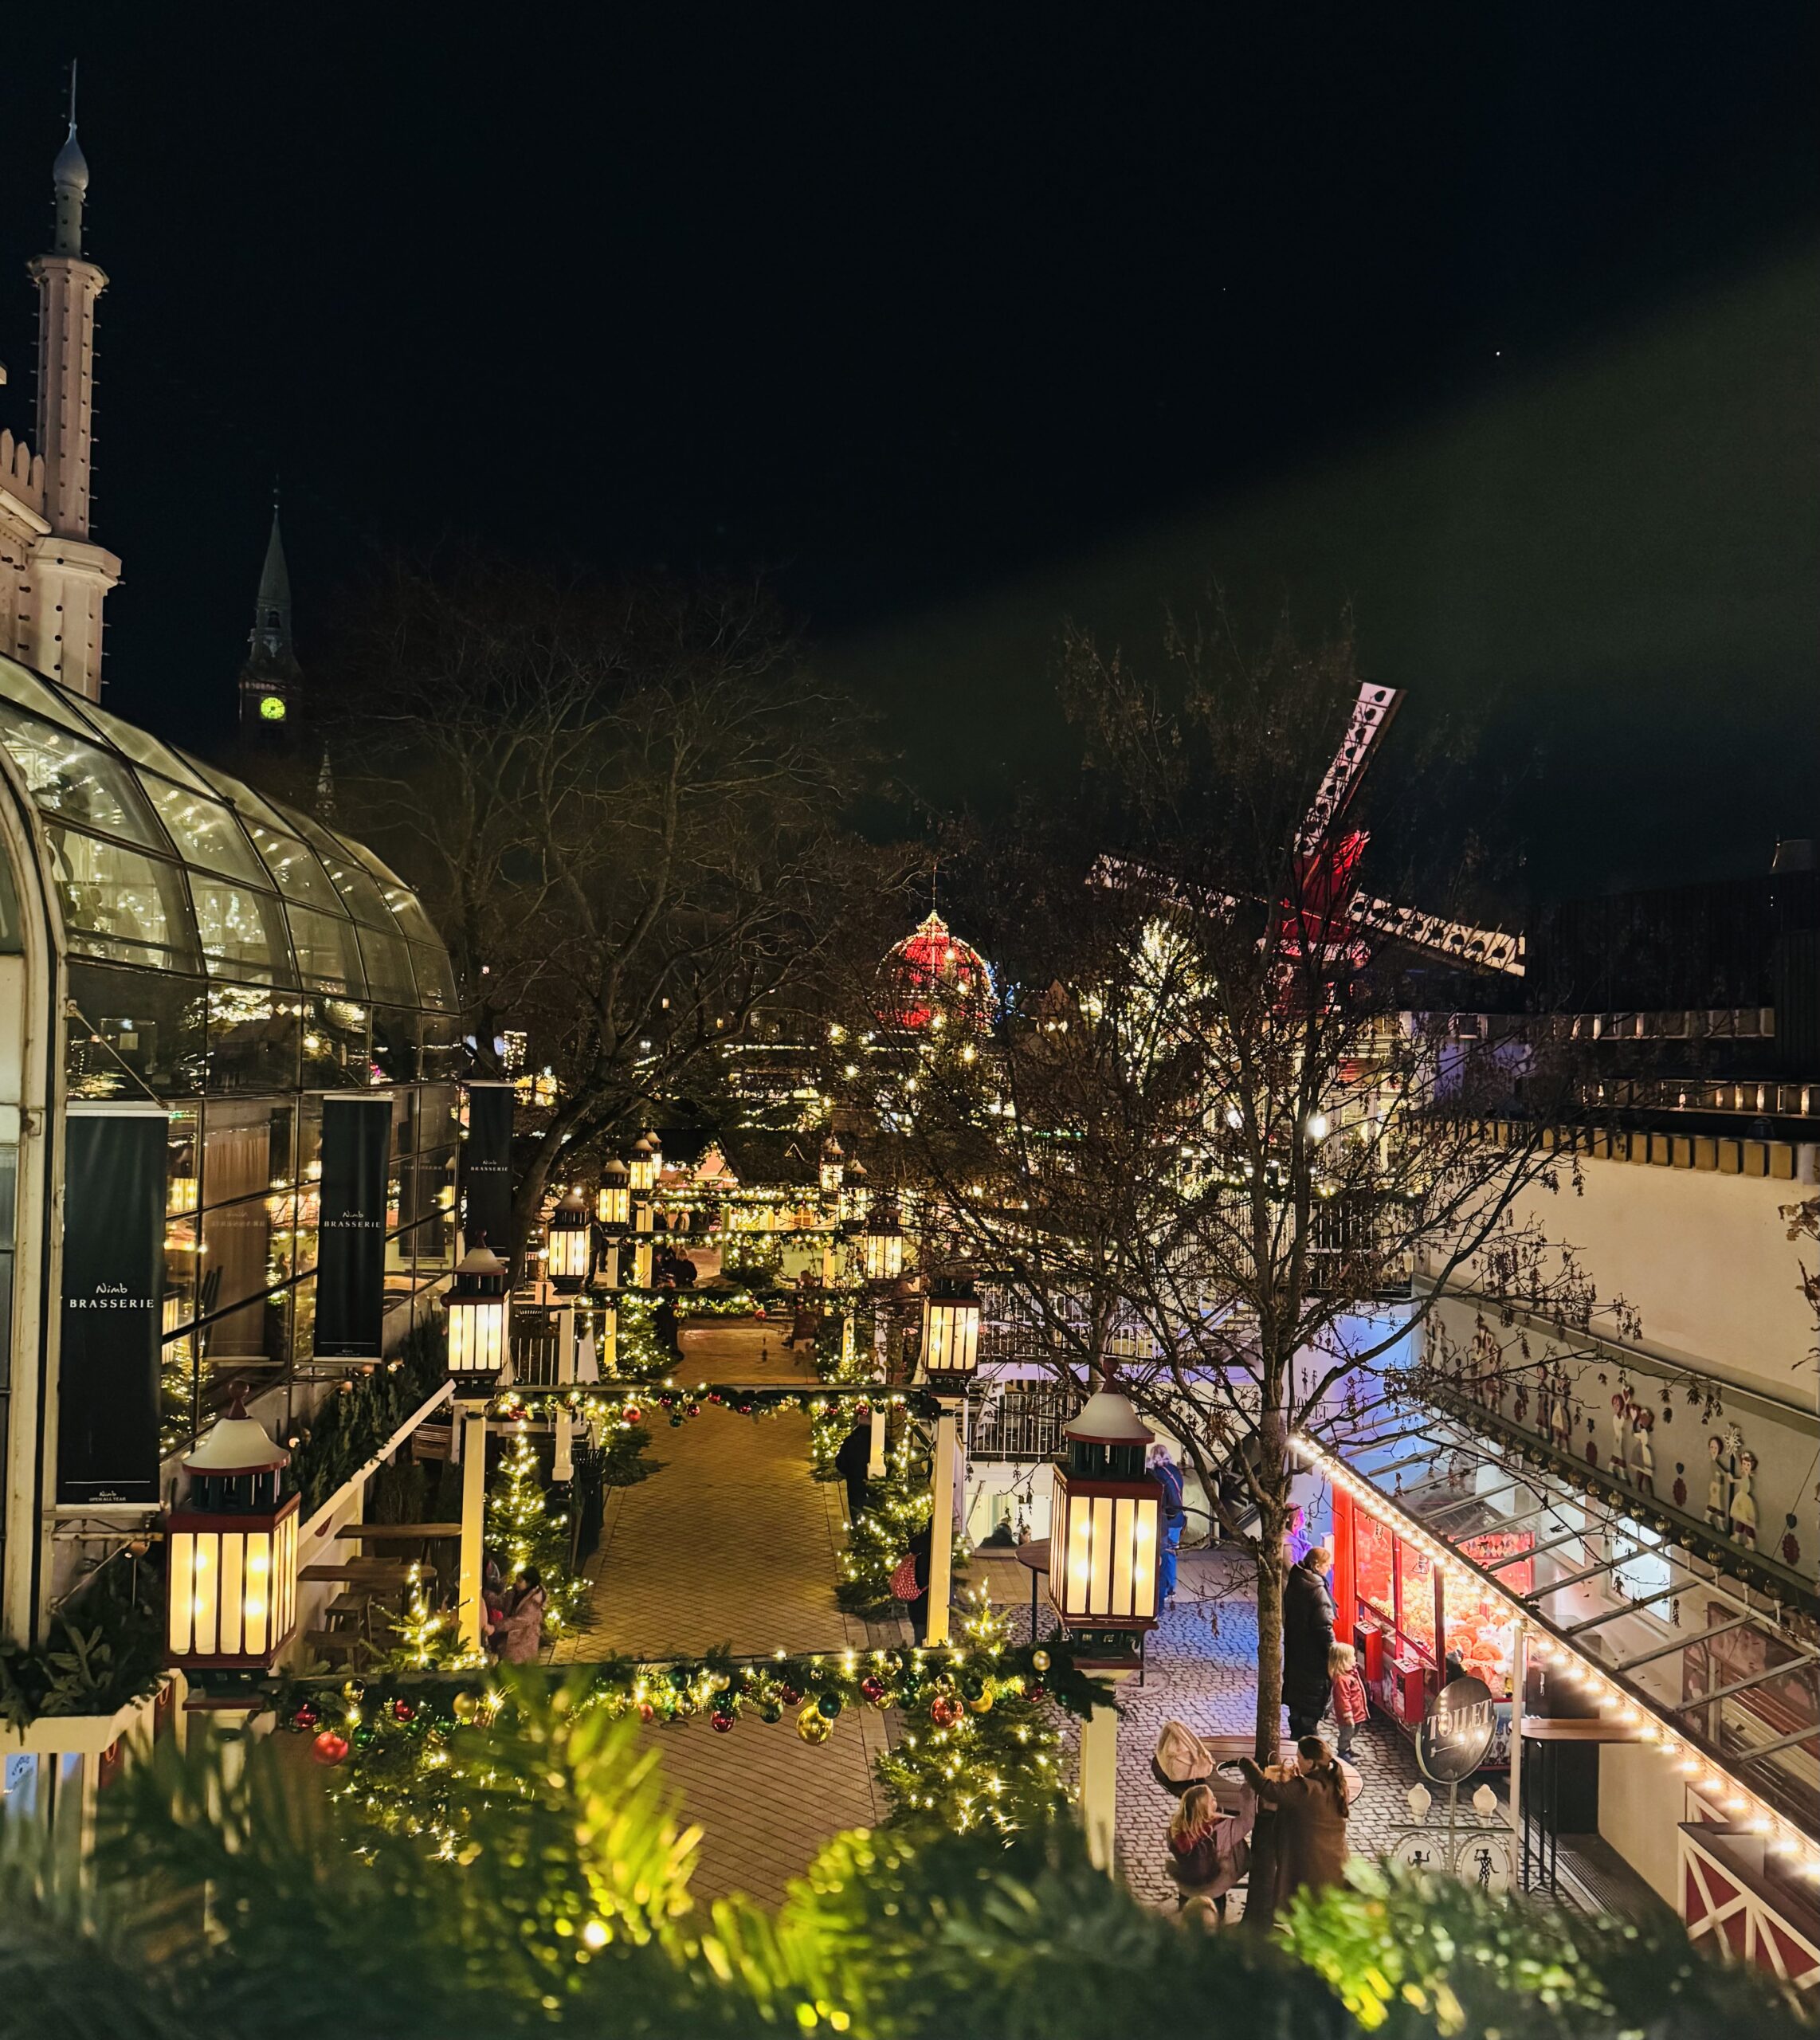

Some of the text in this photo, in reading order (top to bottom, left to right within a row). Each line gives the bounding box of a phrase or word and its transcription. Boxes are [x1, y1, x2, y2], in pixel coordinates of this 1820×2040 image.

[343, 1210, 364, 1218] Nimb
[96, 1282, 127, 1294] Nimb
[69, 1299, 155, 1308] BRASSERIE
[1426, 1698, 1492, 1741] TOILET
